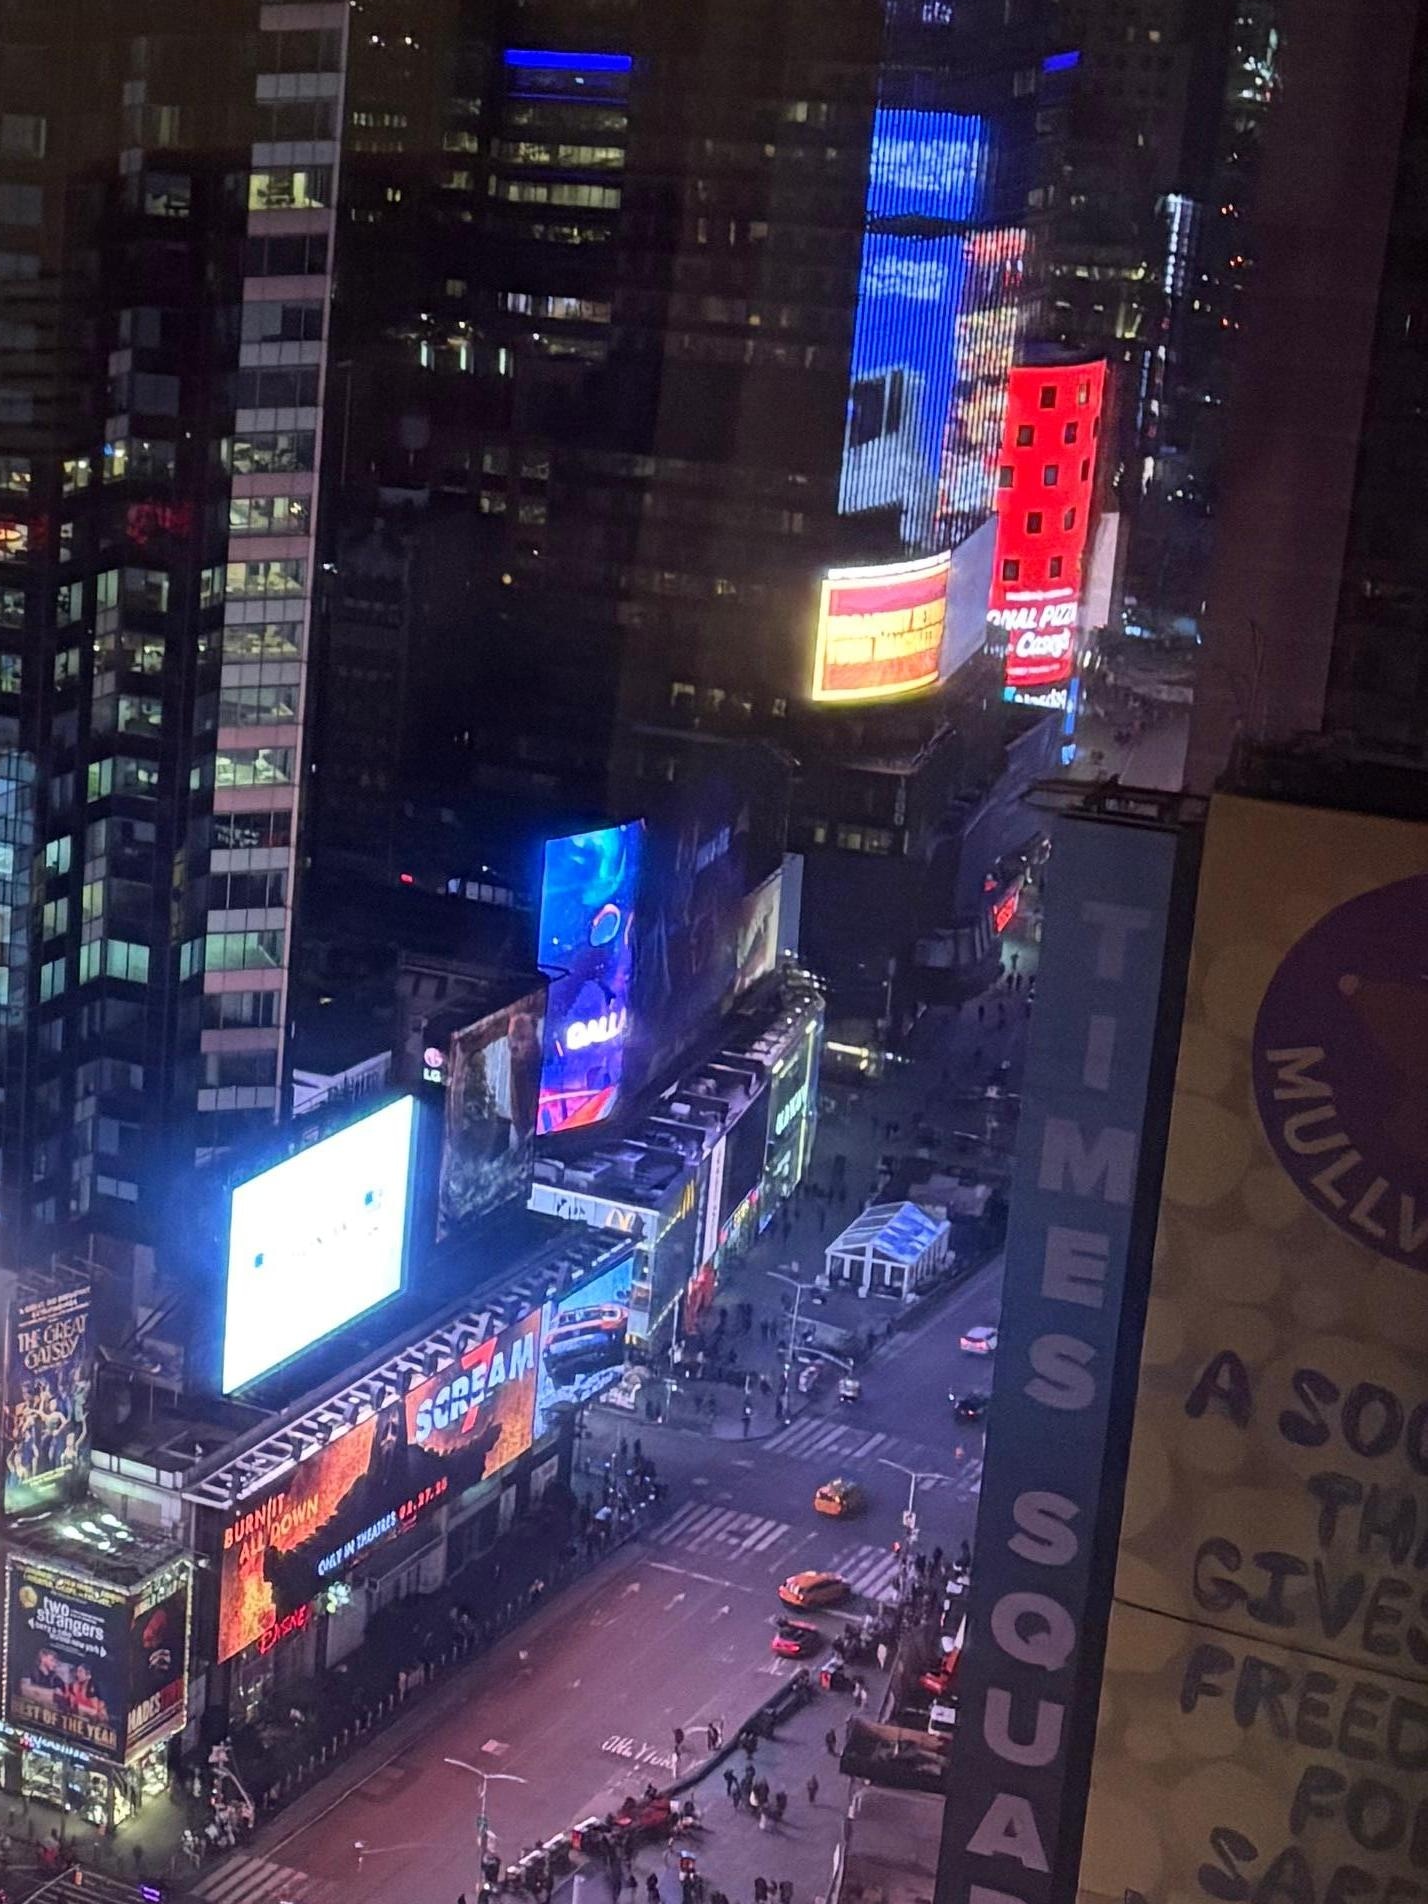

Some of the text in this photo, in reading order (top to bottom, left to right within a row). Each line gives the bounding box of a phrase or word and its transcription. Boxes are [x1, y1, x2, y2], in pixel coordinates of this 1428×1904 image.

[1024, 900, 1151, 1411] TIMES
[416, 1331, 534, 1443] SCREAM
[1185, 1349, 1251, 1429] A
[270, 1494, 319, 1546] DOWN
[1307, 1470, 1428, 1573] TH
[36, 1607, 104, 1642] strangers
[44, 1595, 70, 1618] two
[1290, 1764, 1428, 1868] FO
